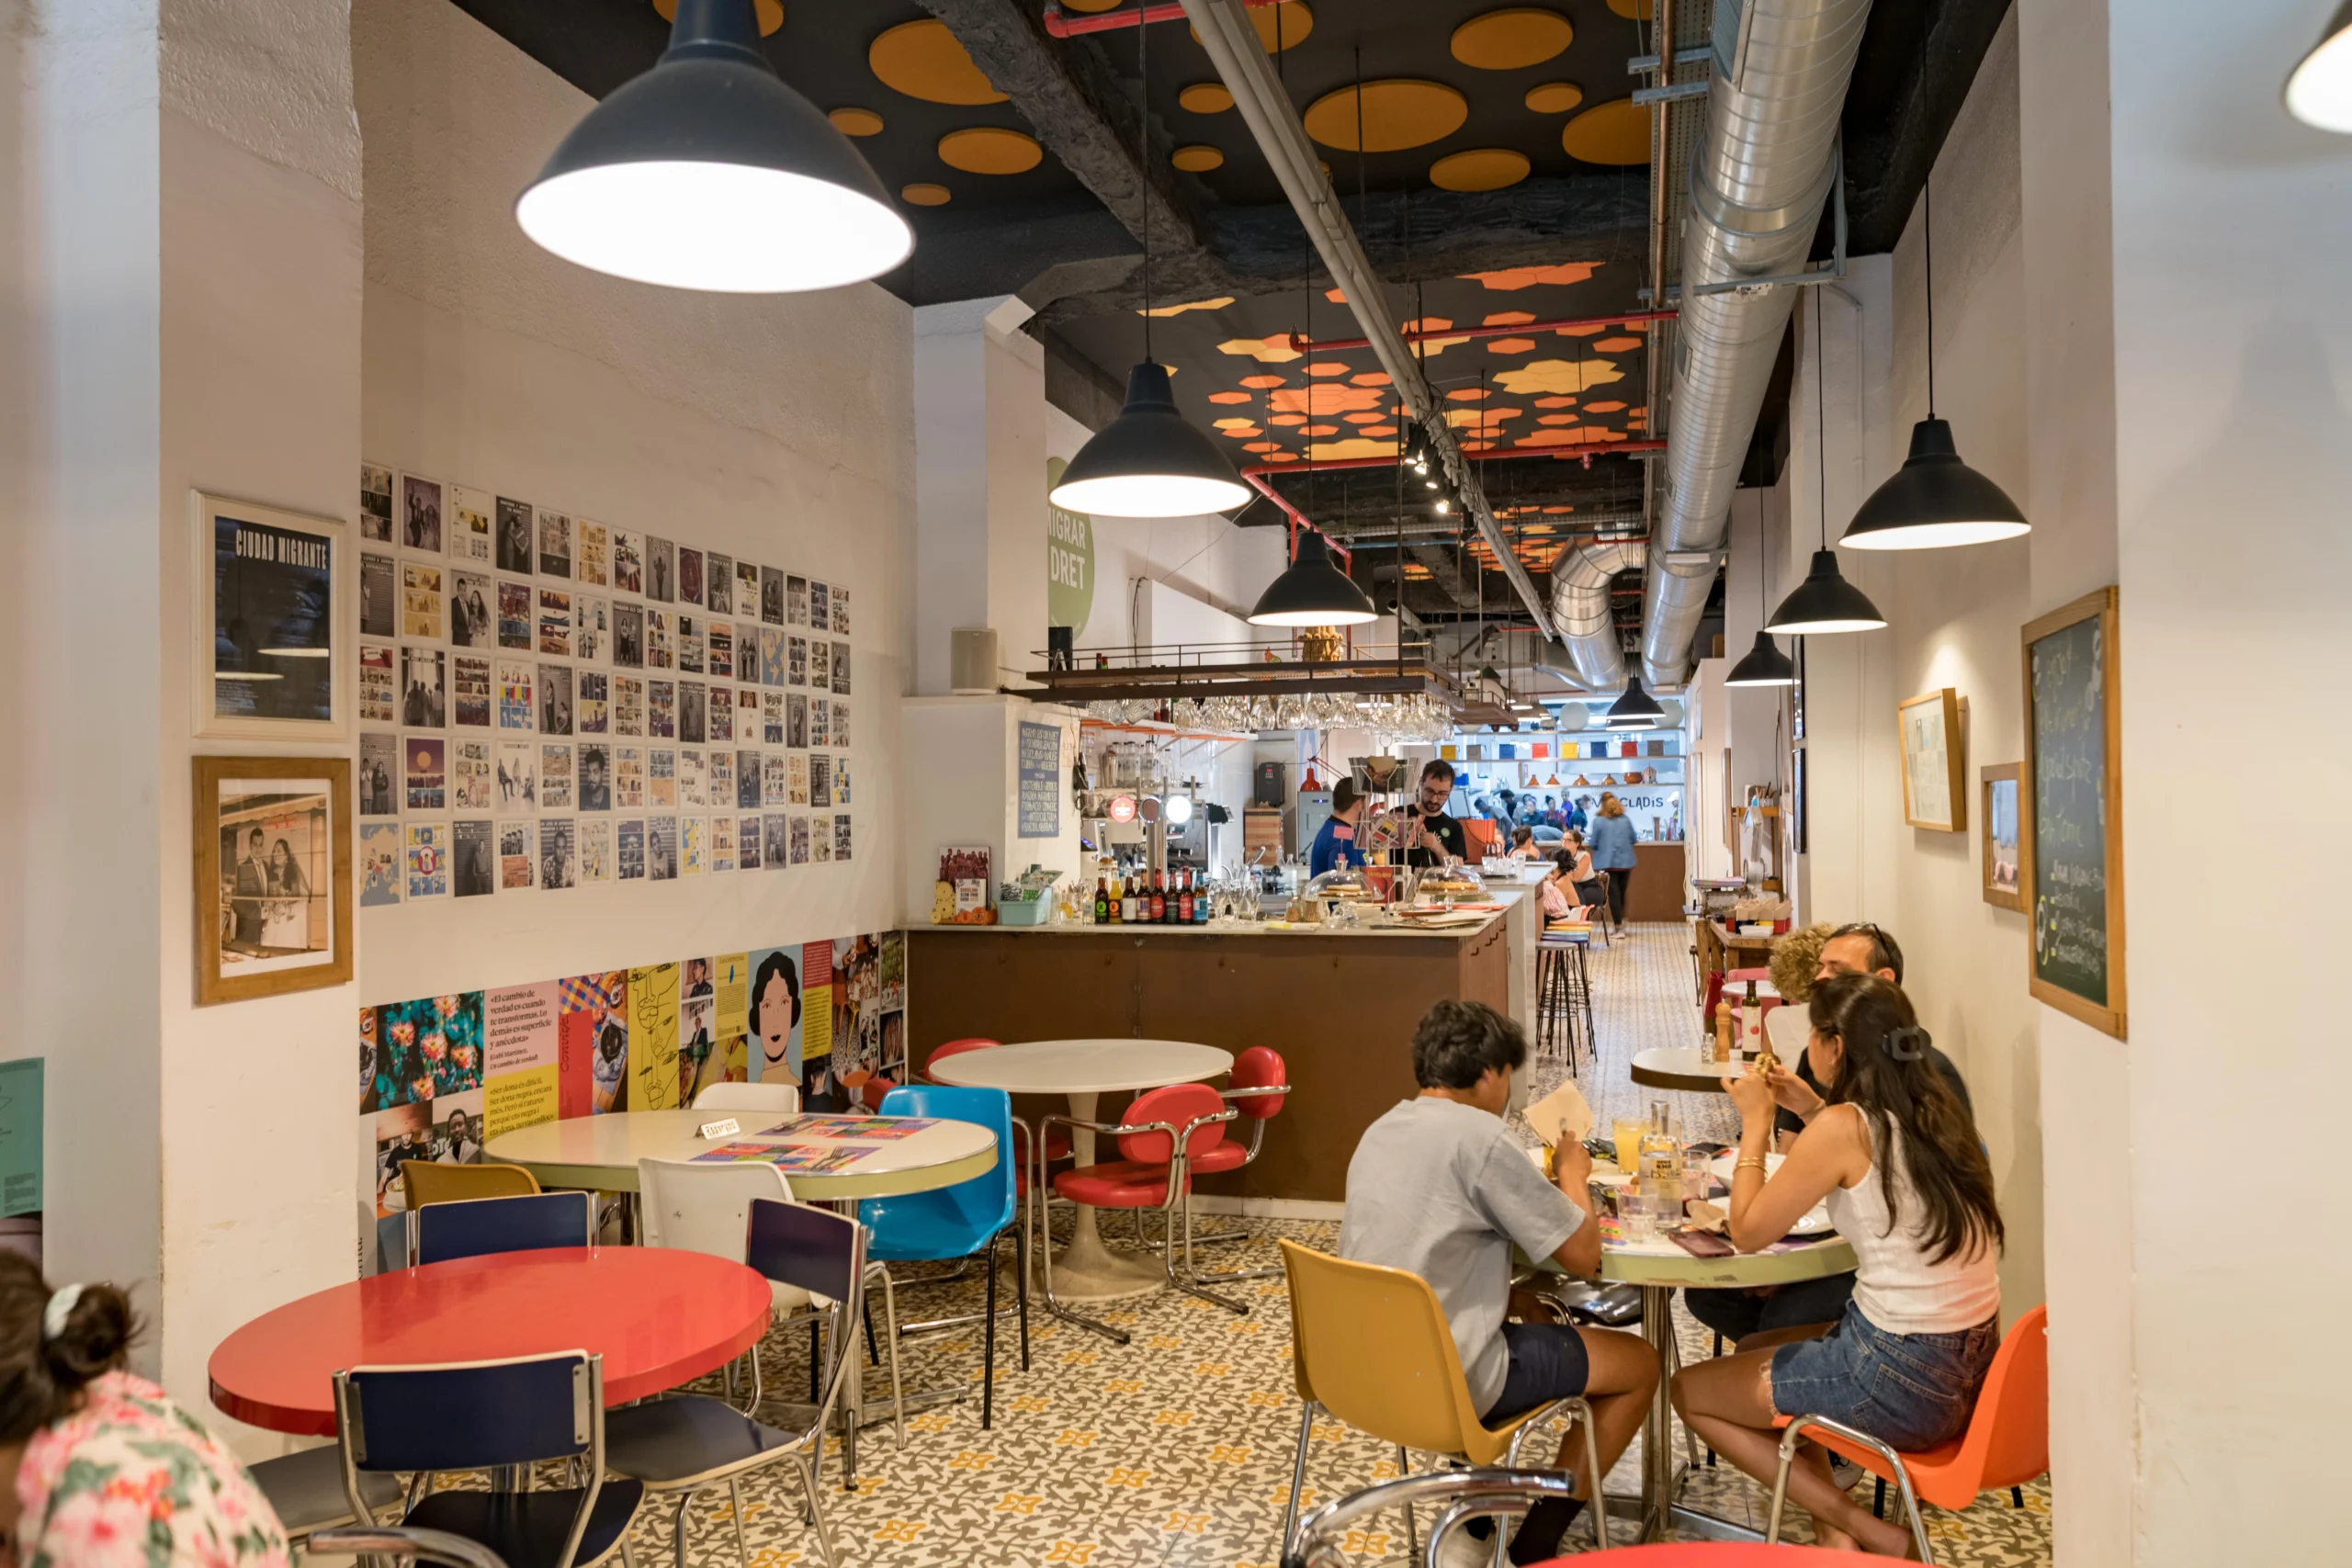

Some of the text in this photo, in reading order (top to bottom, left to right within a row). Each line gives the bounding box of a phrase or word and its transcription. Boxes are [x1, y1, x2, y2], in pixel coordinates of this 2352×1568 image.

[235, 528, 327, 570] CIUDAD MIGRANTE
[1050, 545, 1086, 590] DRET
[502, 991, 526, 1001] cambio
[527, 989, 536, 998] de
[490, 1004, 514, 1014] verdad
[522, 998, 546, 1010] cuando
[490, 1018, 497, 1026] te
[498, 1012, 539, 1024] transformas.
[490, 1025, 513, 1037] demás
[521, 1019, 552, 1032] superficie
[490, 1041, 494, 1050] y
[497, 1059, 514, 1068] cambio
[490, 1098, 499, 1106] Ser
[500, 1094, 515, 1103] dona
[533, 1085, 552, 1095] encara
[503, 1084, 518, 1092] dona
[490, 1113, 510, 1128] perquè
[521, 1109, 537, 1118] negra
